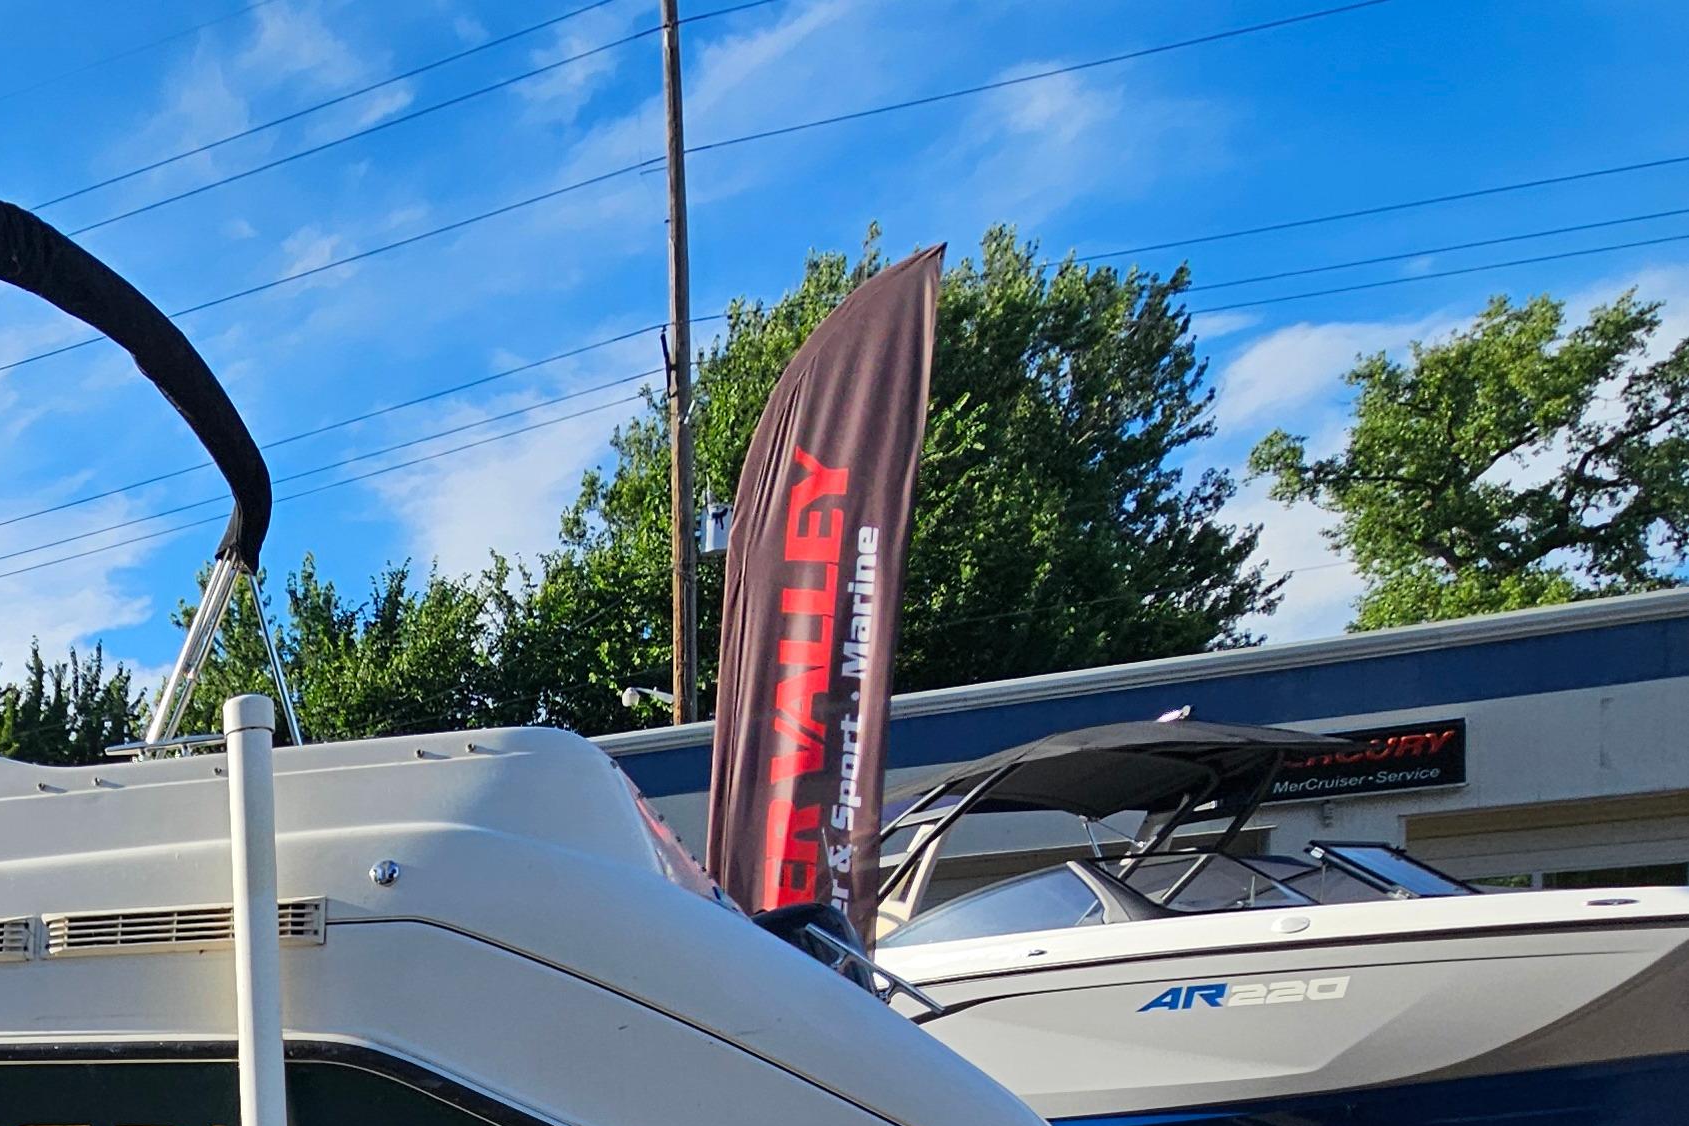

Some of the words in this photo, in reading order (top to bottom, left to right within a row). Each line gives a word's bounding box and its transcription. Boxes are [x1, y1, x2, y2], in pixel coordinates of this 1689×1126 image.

[770, 445, 850, 785] VALLEY
[841, 525, 880, 681] Marine
[830, 713, 863, 832] Sport
[1375, 766, 1442, 785] Service
